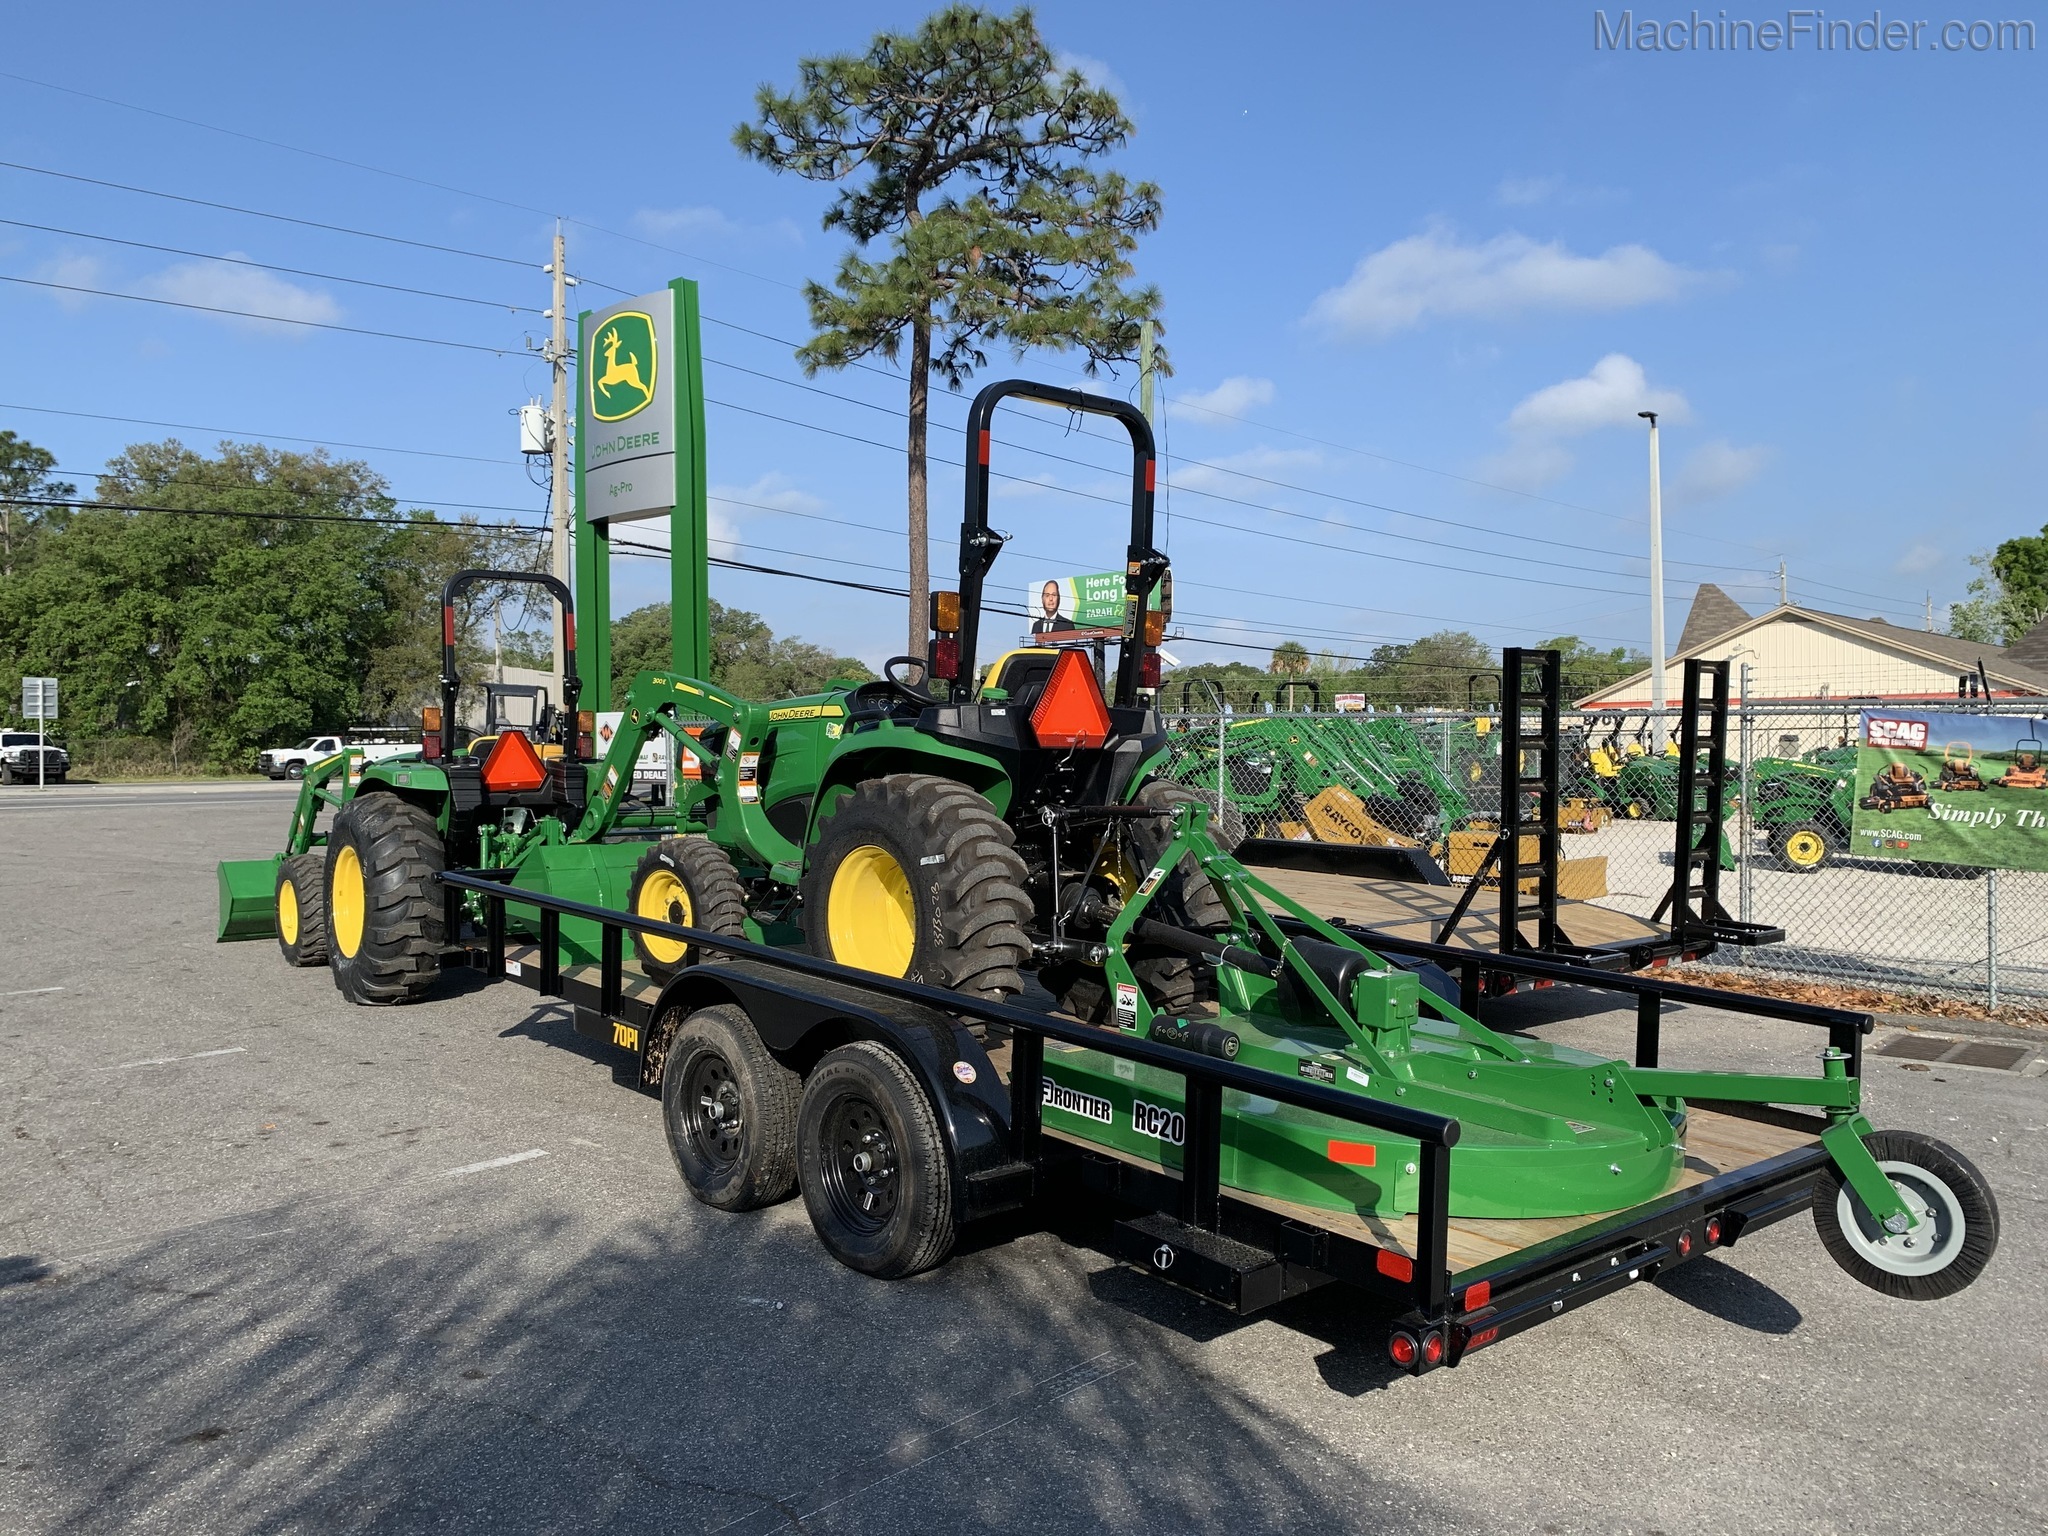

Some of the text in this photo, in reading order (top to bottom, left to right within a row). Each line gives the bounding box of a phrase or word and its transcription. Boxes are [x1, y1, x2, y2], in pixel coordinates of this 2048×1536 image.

[592, 431, 659, 459] JOHN DEERE
[609, 481, 633, 497] Ag-Pro
[1086, 575, 1126, 588] Here Fo
[1086, 588, 1118, 602] Long
[1086, 607, 1113, 618] FARAH
[770, 709, 815, 720] JOHN DEERE
[1869, 720, 1926, 741] SCAG
[633, 770, 667, 779] ED DEALE
[1321, 803, 1362, 838] RAYCO
[1927, 802, 2048, 830] Simply Th
[1860, 828, 1922, 841] www.SCAG.com
[613, 1022, 639, 1051] 70PI
